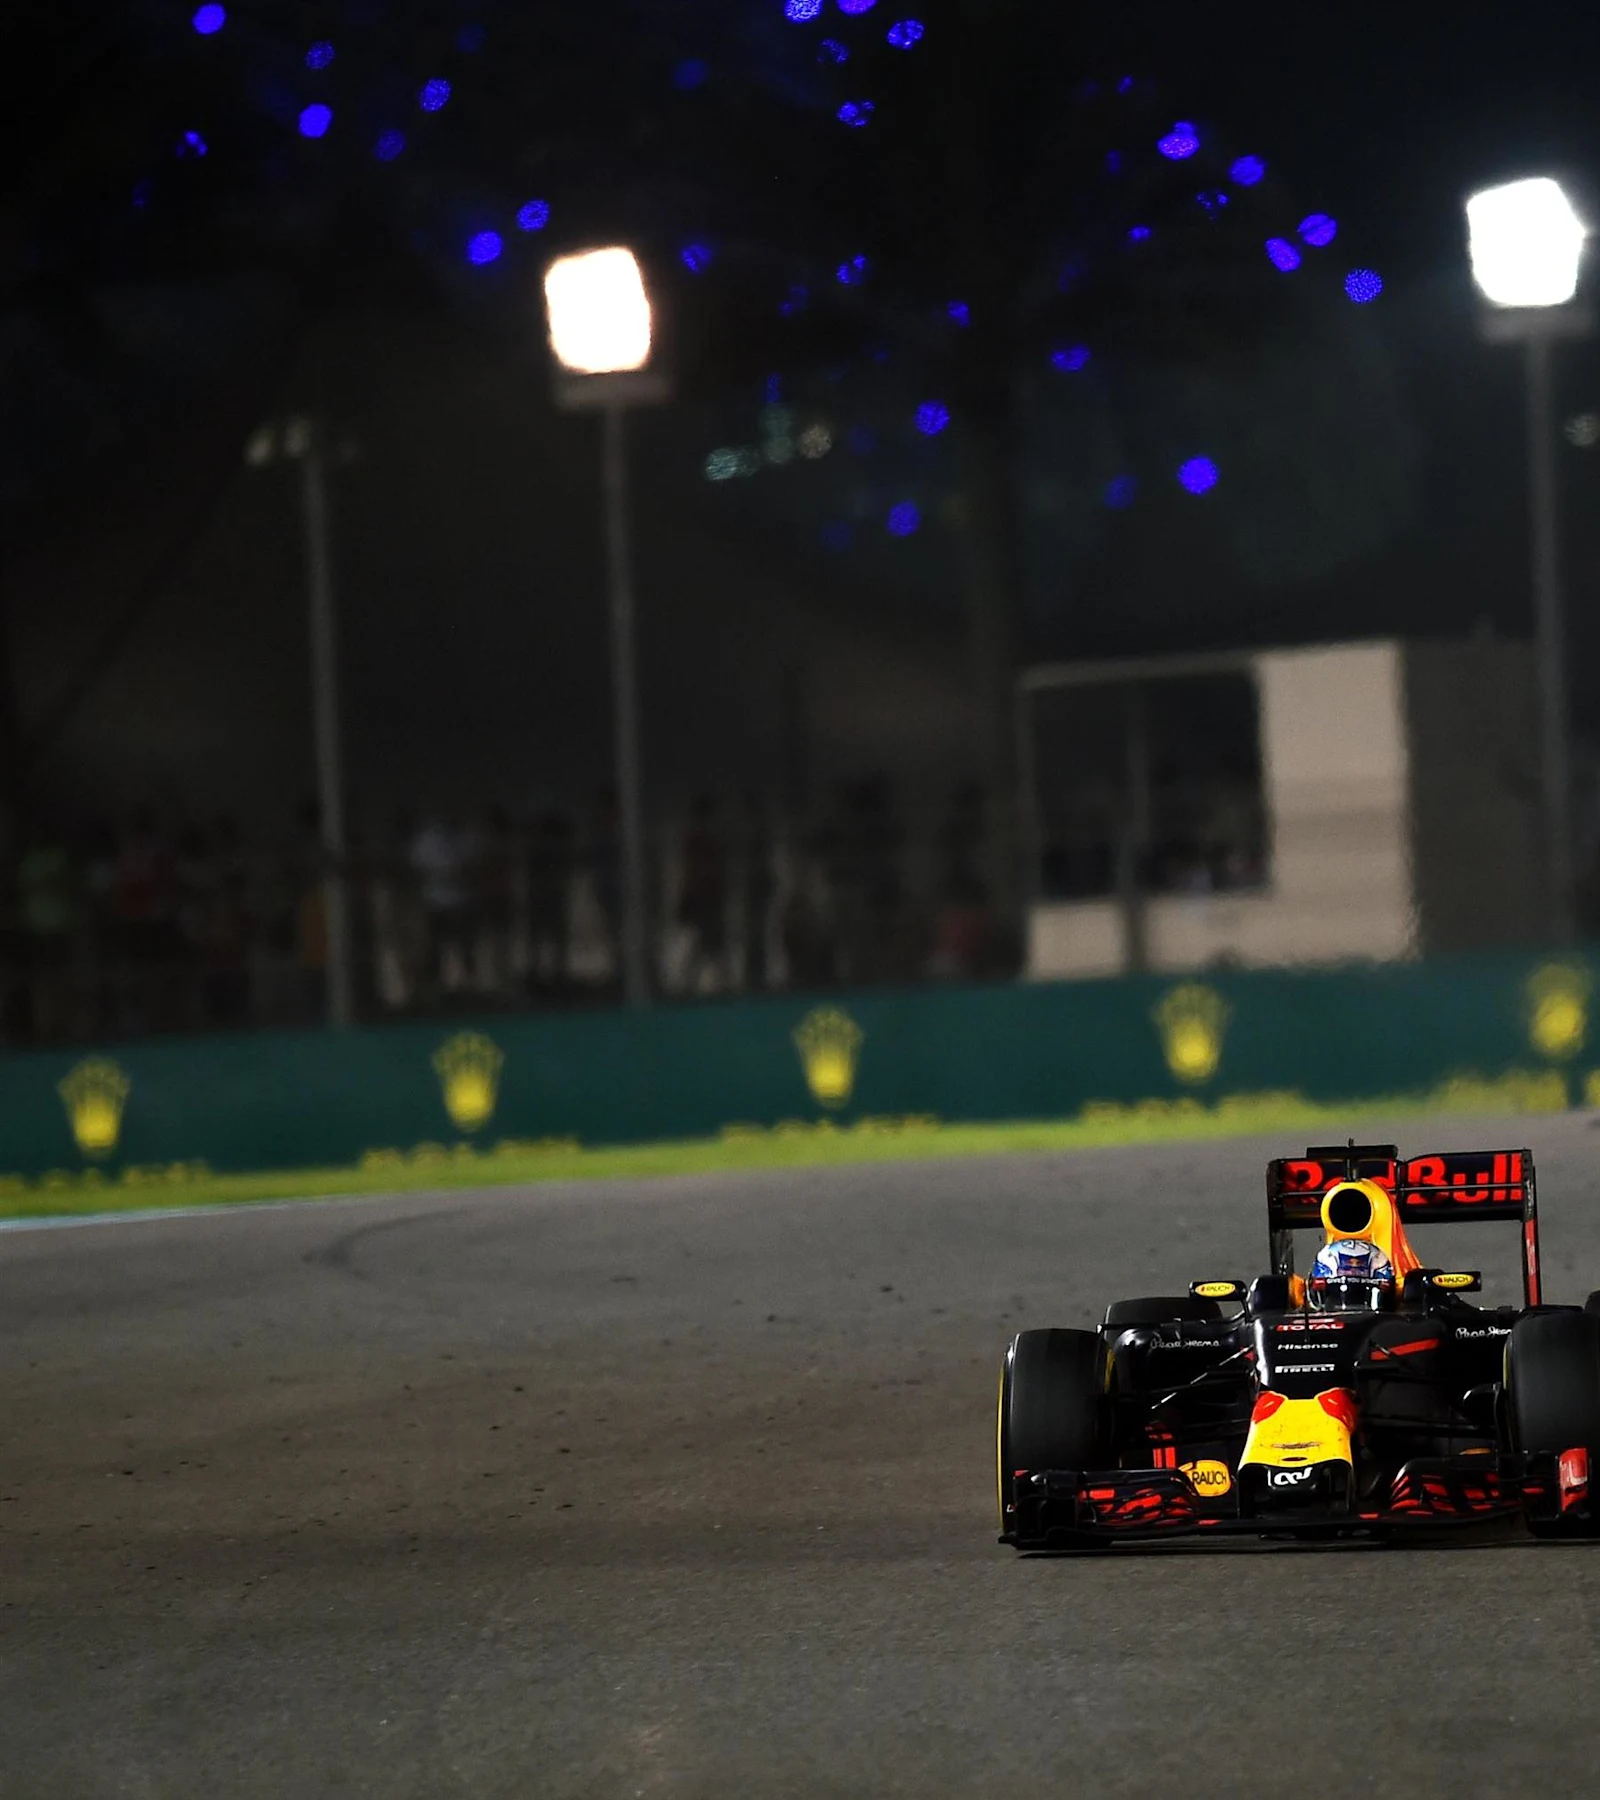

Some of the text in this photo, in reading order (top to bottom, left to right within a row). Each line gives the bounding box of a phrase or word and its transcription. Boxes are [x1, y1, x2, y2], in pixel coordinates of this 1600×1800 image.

[1407, 1153, 1522, 1204] Bull
[1277, 1323, 1344, 1331] TOTAL
[1192, 1470, 1226, 1485] RAUCH
